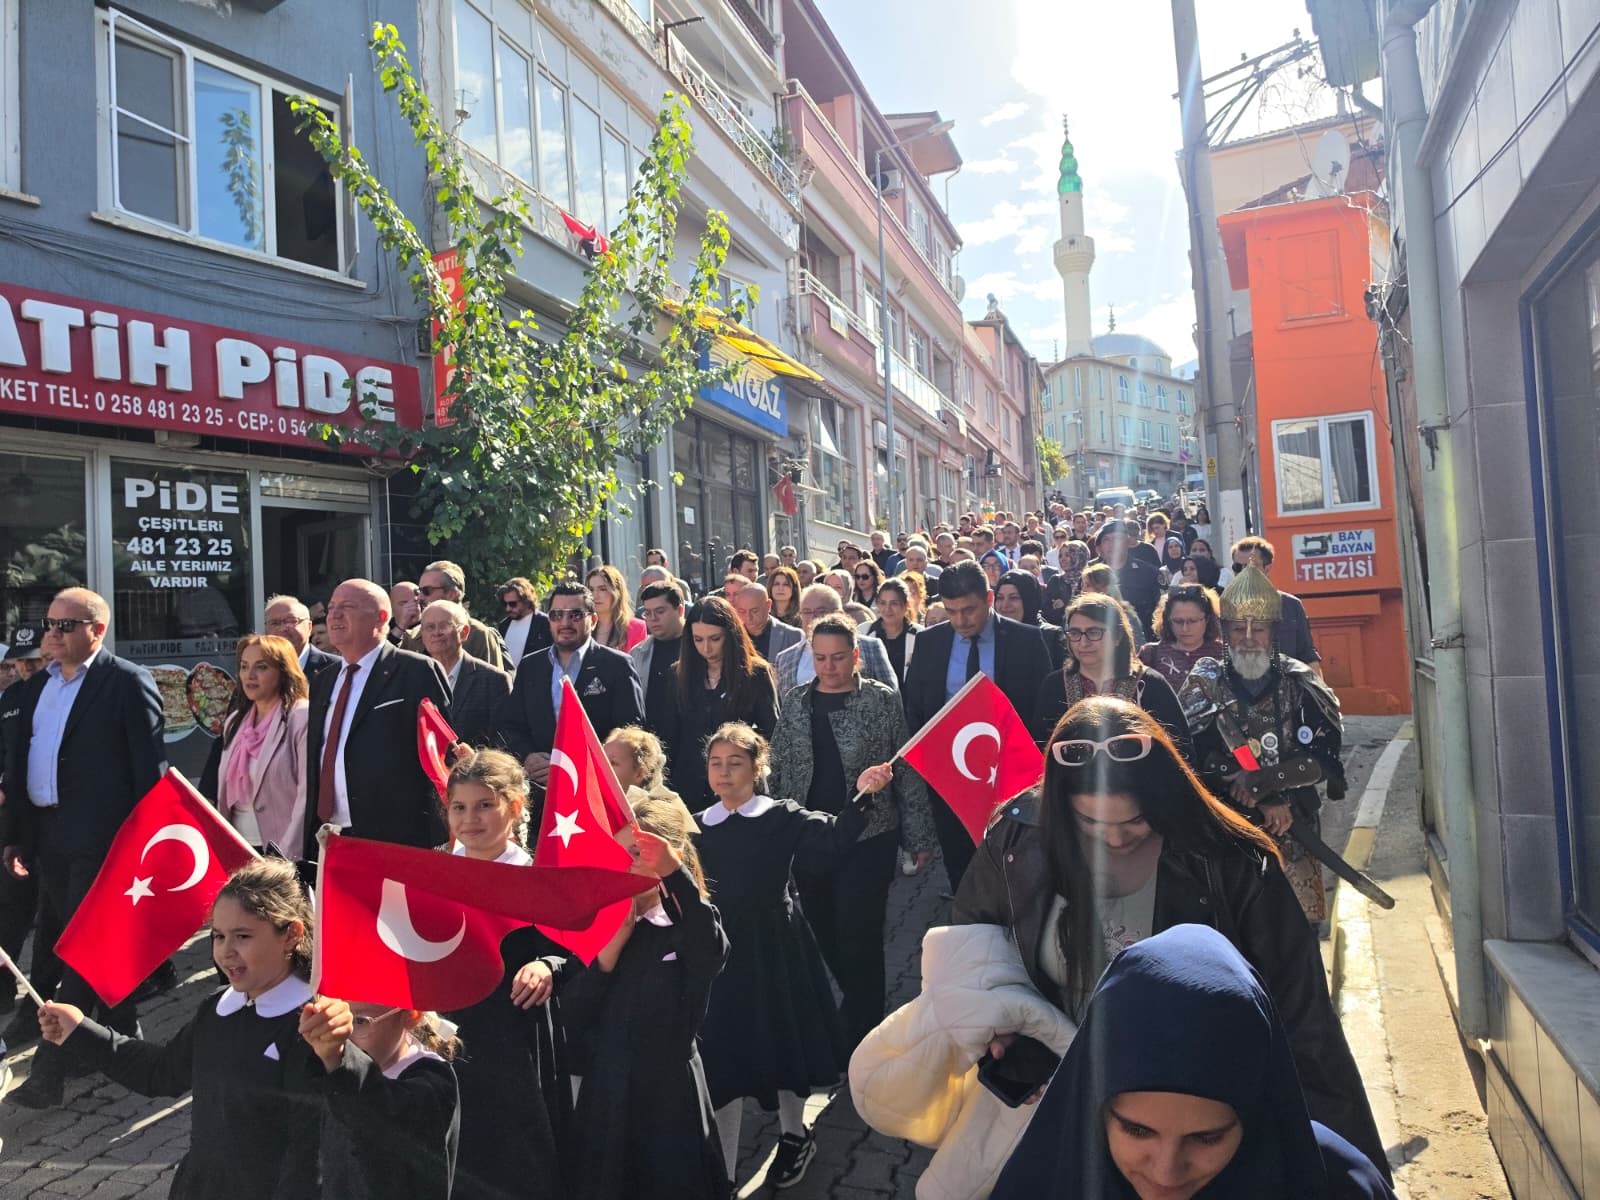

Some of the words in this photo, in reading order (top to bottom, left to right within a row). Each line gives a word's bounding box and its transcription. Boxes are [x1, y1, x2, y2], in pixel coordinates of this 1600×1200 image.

[46, 384, 89, 409] TEL:
[95, 391, 106, 411] 0
[111, 394, 142, 416] 258
[148, 399, 175, 420] 481
[182, 403, 201, 423] 23
[205, 407, 224, 426] 25
[238, 410, 274, 433] CEP:
[278, 418, 287, 435] 0
[124, 477, 240, 514] PiDE
[1338, 530, 1362, 541] BAY
[126, 537, 166, 555] 481
[174, 538, 201, 555] 23
[207, 539, 233, 555] 25
[1331, 542, 1373, 554] BAYAN
[1301, 555, 1373, 581] TERZİSİ
[149, 576, 208, 588] VARDIR
